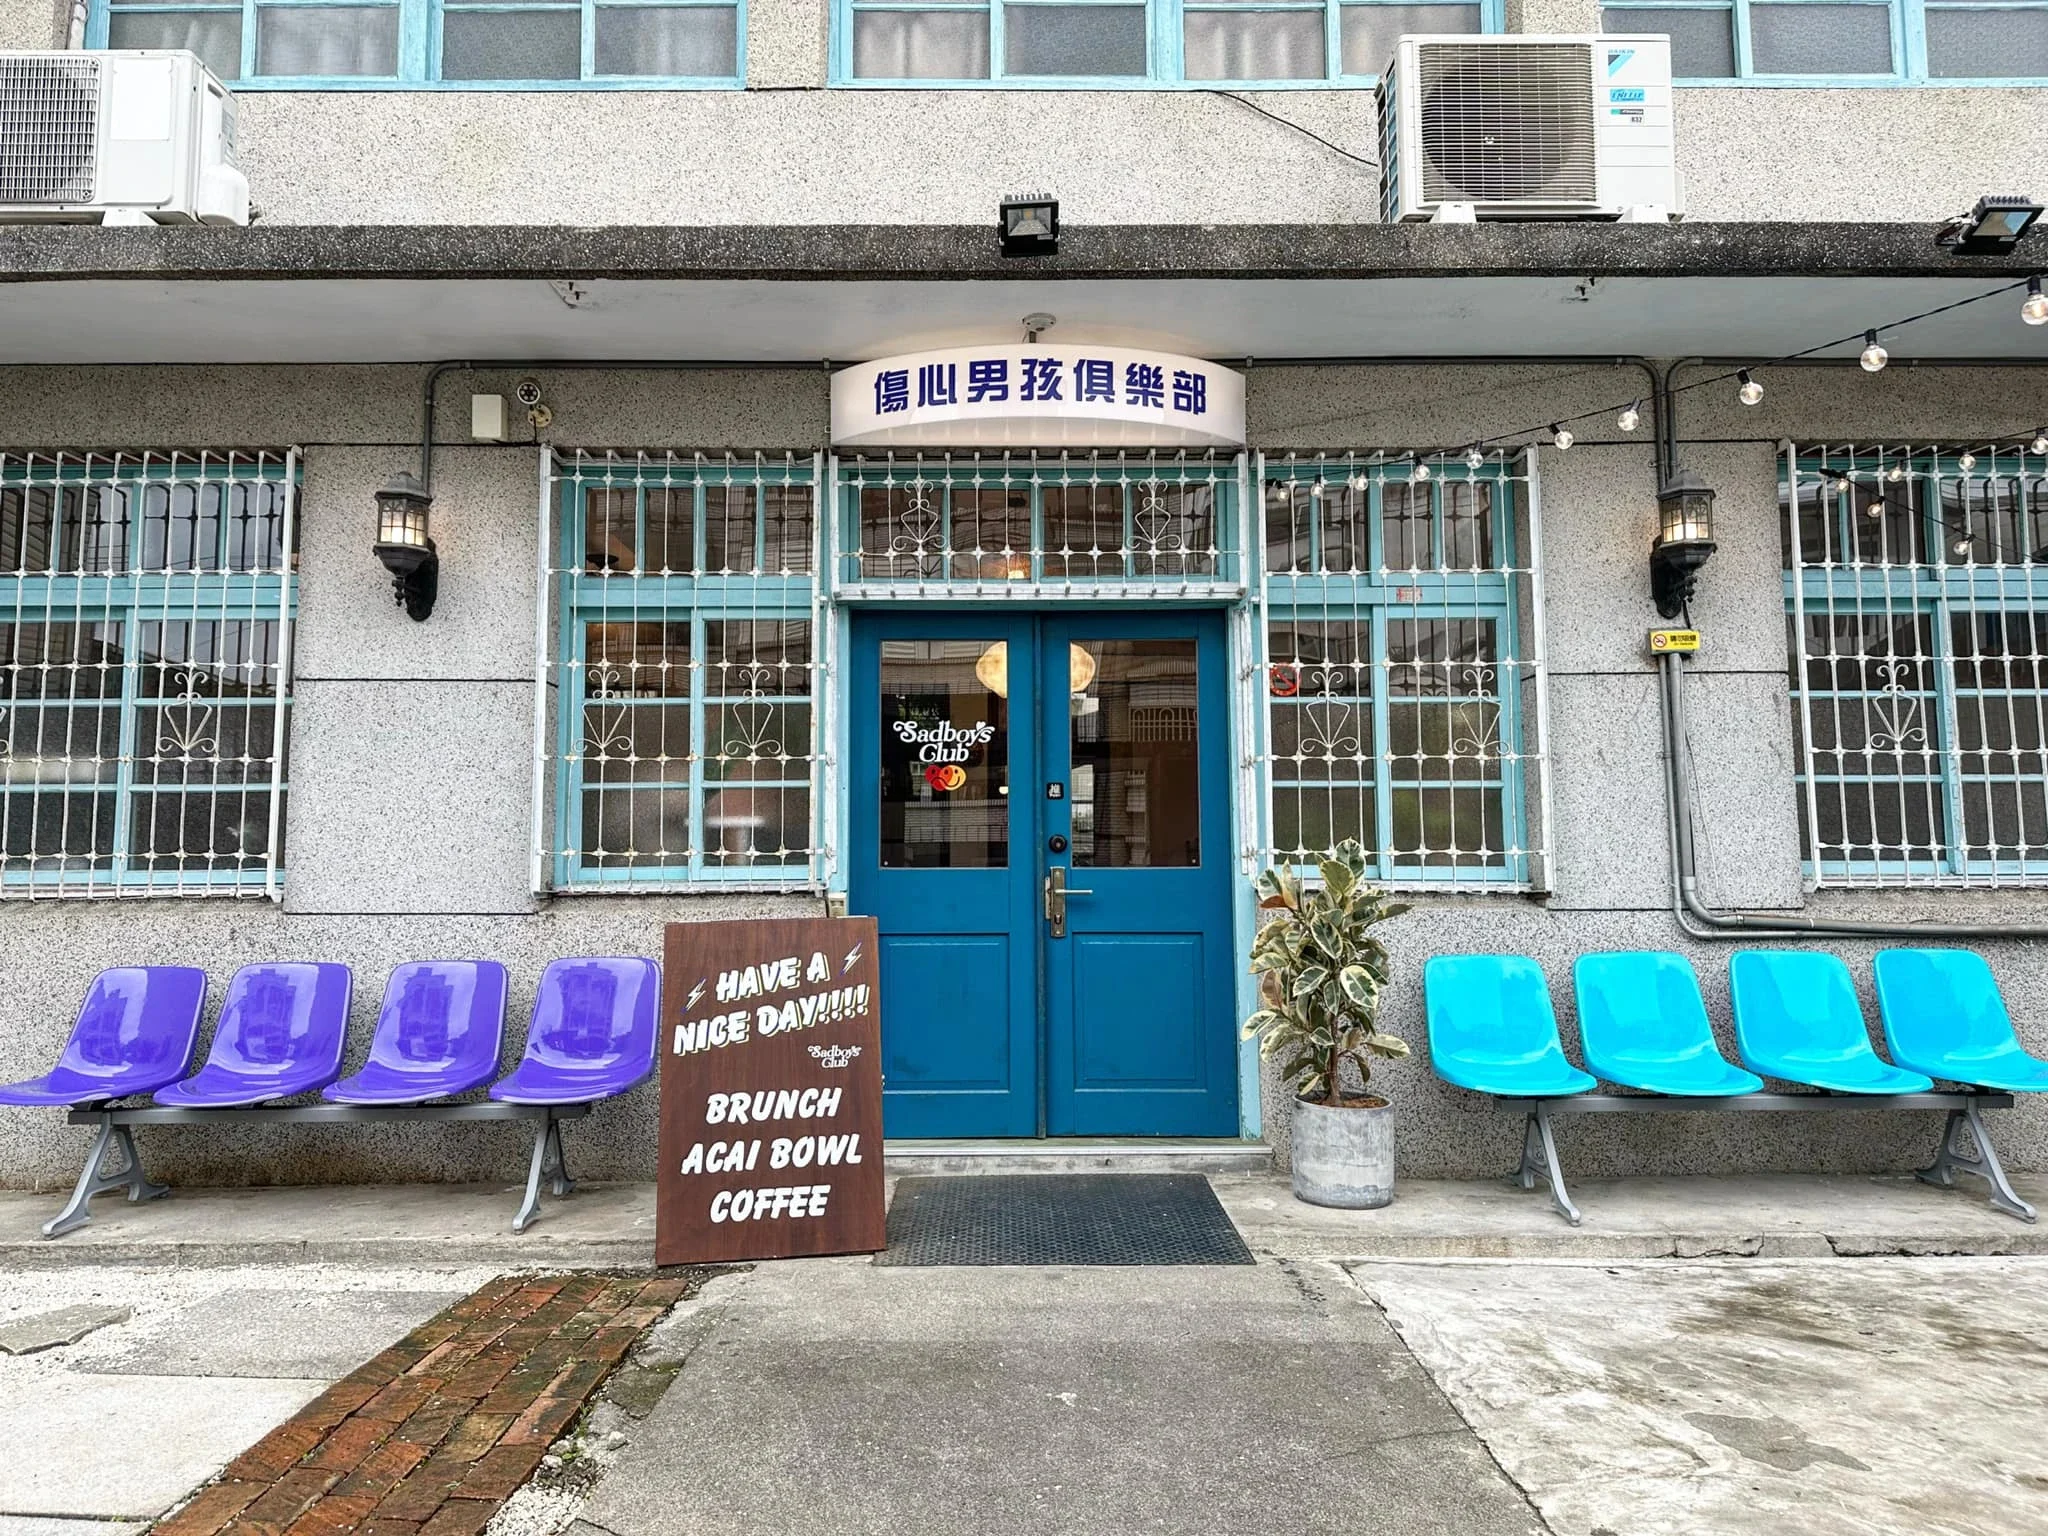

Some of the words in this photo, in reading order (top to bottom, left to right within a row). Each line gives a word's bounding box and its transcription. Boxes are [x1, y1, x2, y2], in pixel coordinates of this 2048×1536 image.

[874, 358, 1207, 415] 傷心男孩俱樂部
[919, 742, 969, 762] Club
[715, 957, 801, 1003] HAVE
[806, 952, 830, 983] A
[673, 1011, 751, 1057] NICE
[756, 983, 871, 1038] DAY!!!!
[821, 1055, 849, 1069] Club
[705, 1087, 843, 1125] BRUNCH
[680, 1139, 762, 1175] ACAI
[769, 1133, 863, 1170] BOWL
[709, 1184, 831, 1223] COFFEE
